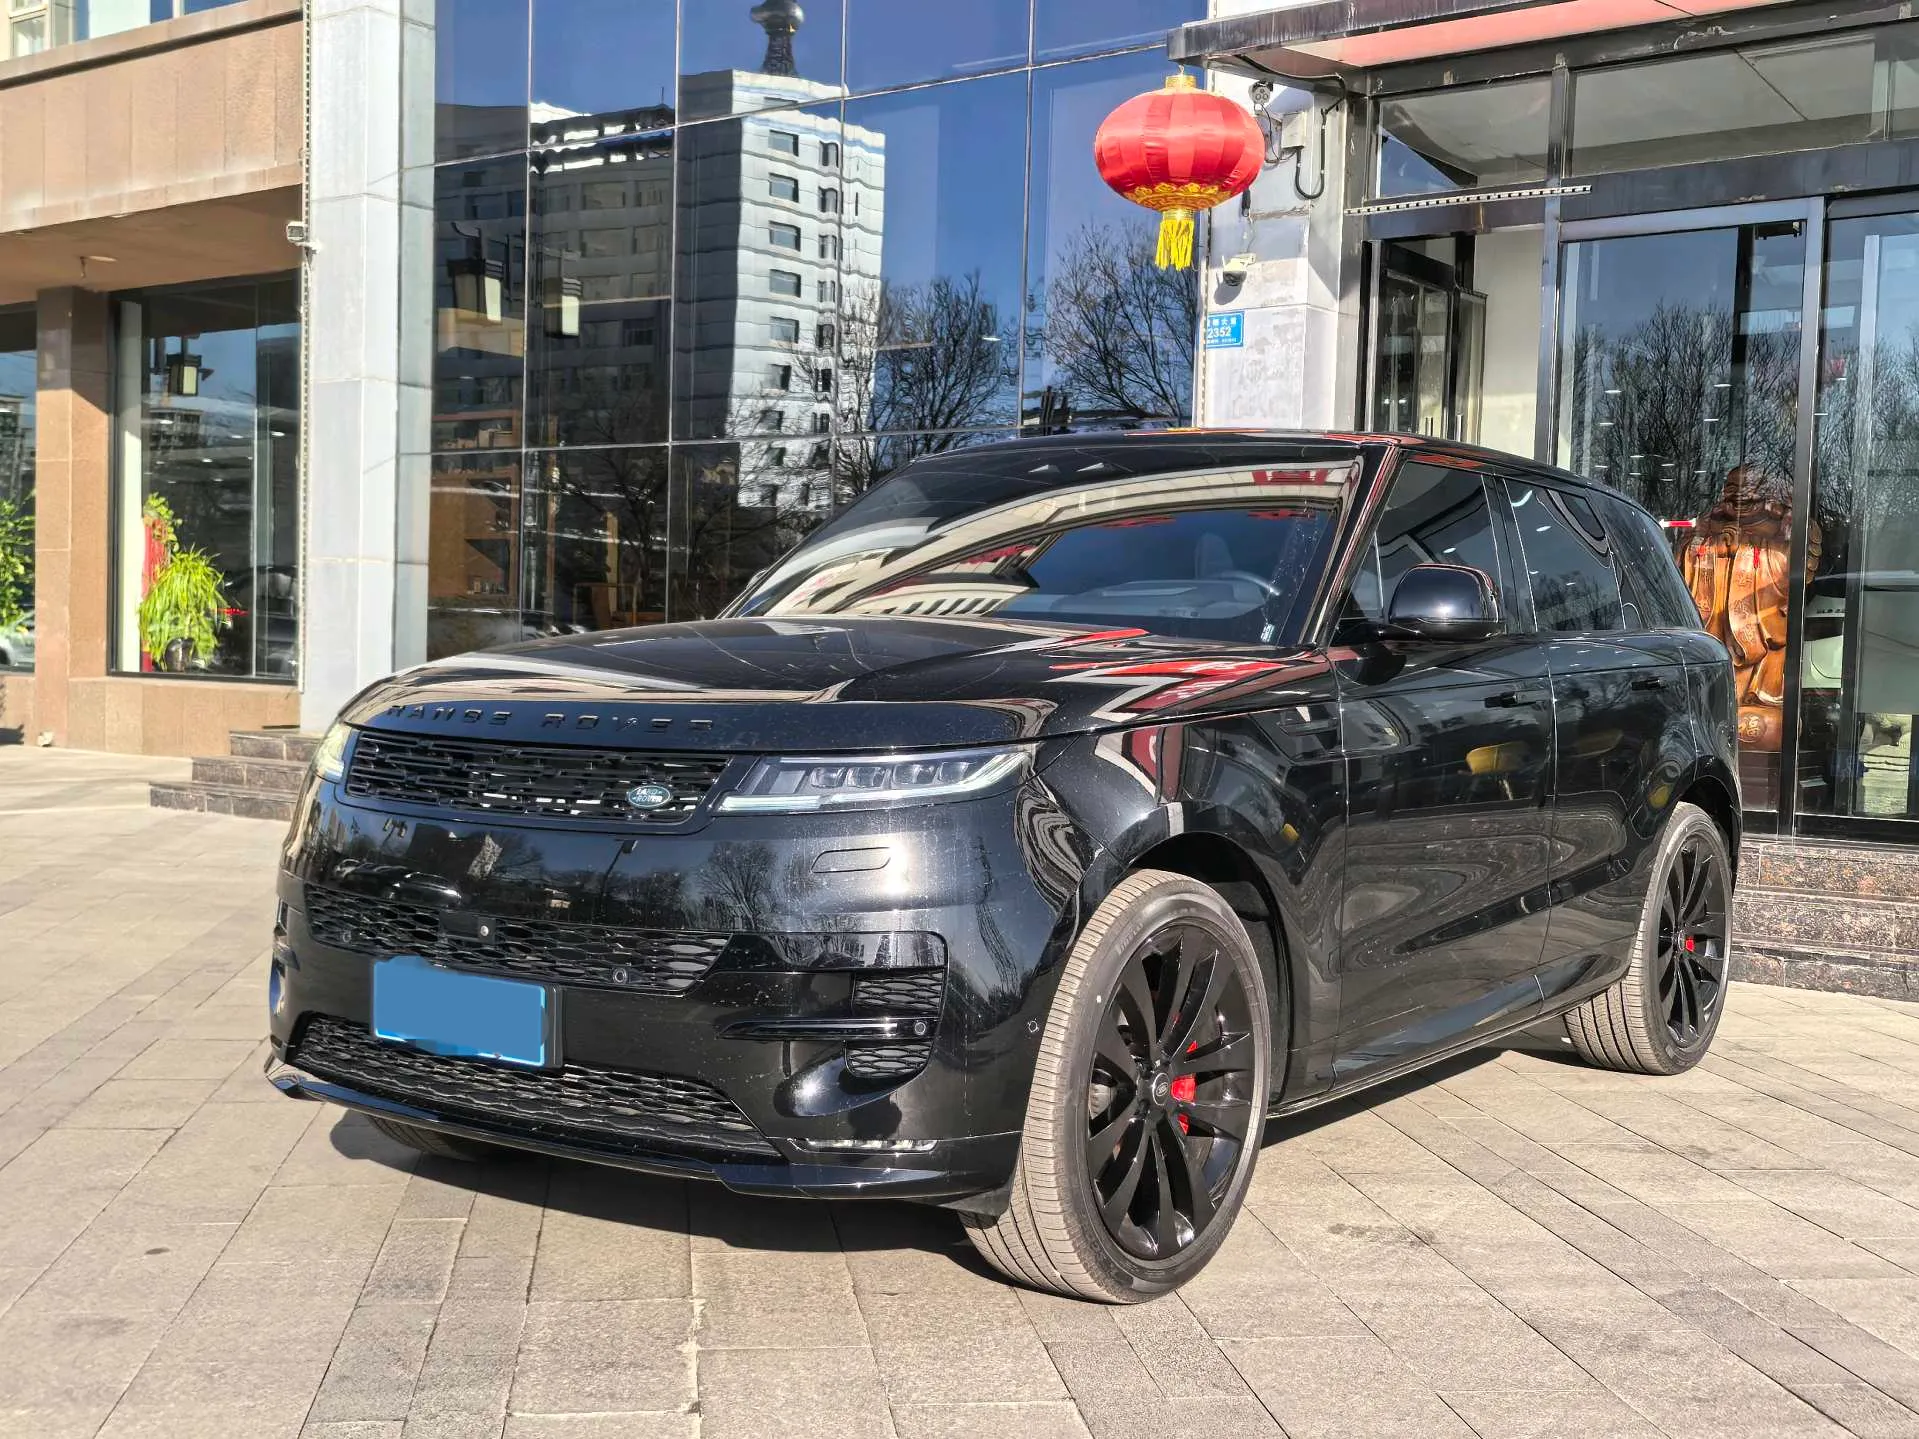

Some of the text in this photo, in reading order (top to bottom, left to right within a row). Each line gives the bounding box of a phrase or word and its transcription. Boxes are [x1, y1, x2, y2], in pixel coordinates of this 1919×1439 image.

[1207, 327, 1231, 338] 2352
[386, 704, 713, 734] RANGE ROVER
